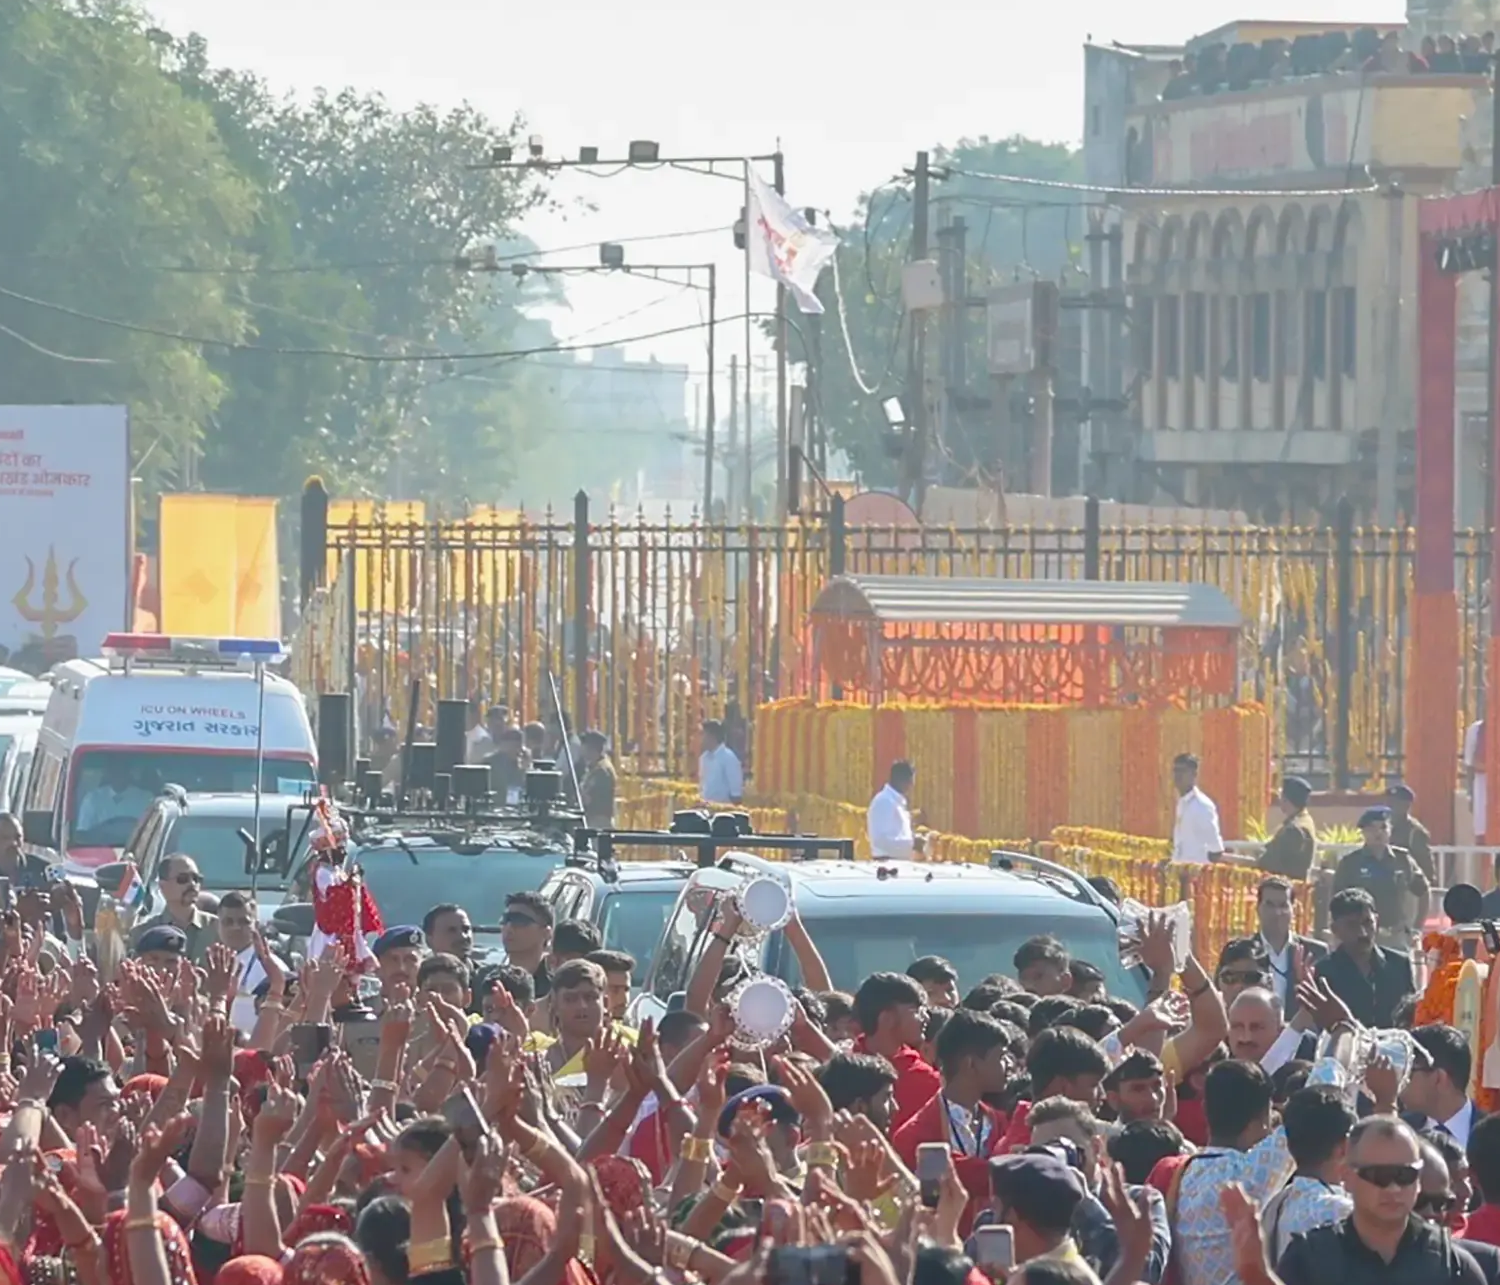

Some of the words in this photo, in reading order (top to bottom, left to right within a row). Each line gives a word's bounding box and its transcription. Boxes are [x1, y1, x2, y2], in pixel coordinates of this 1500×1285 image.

[141, 704, 164, 714] ICU
[167, 705, 187, 715] ON
[190, 706, 246, 720] WHEELS
[132, 719, 195, 737] ગુજરાત
[204, 721, 259, 736] સરકાર
